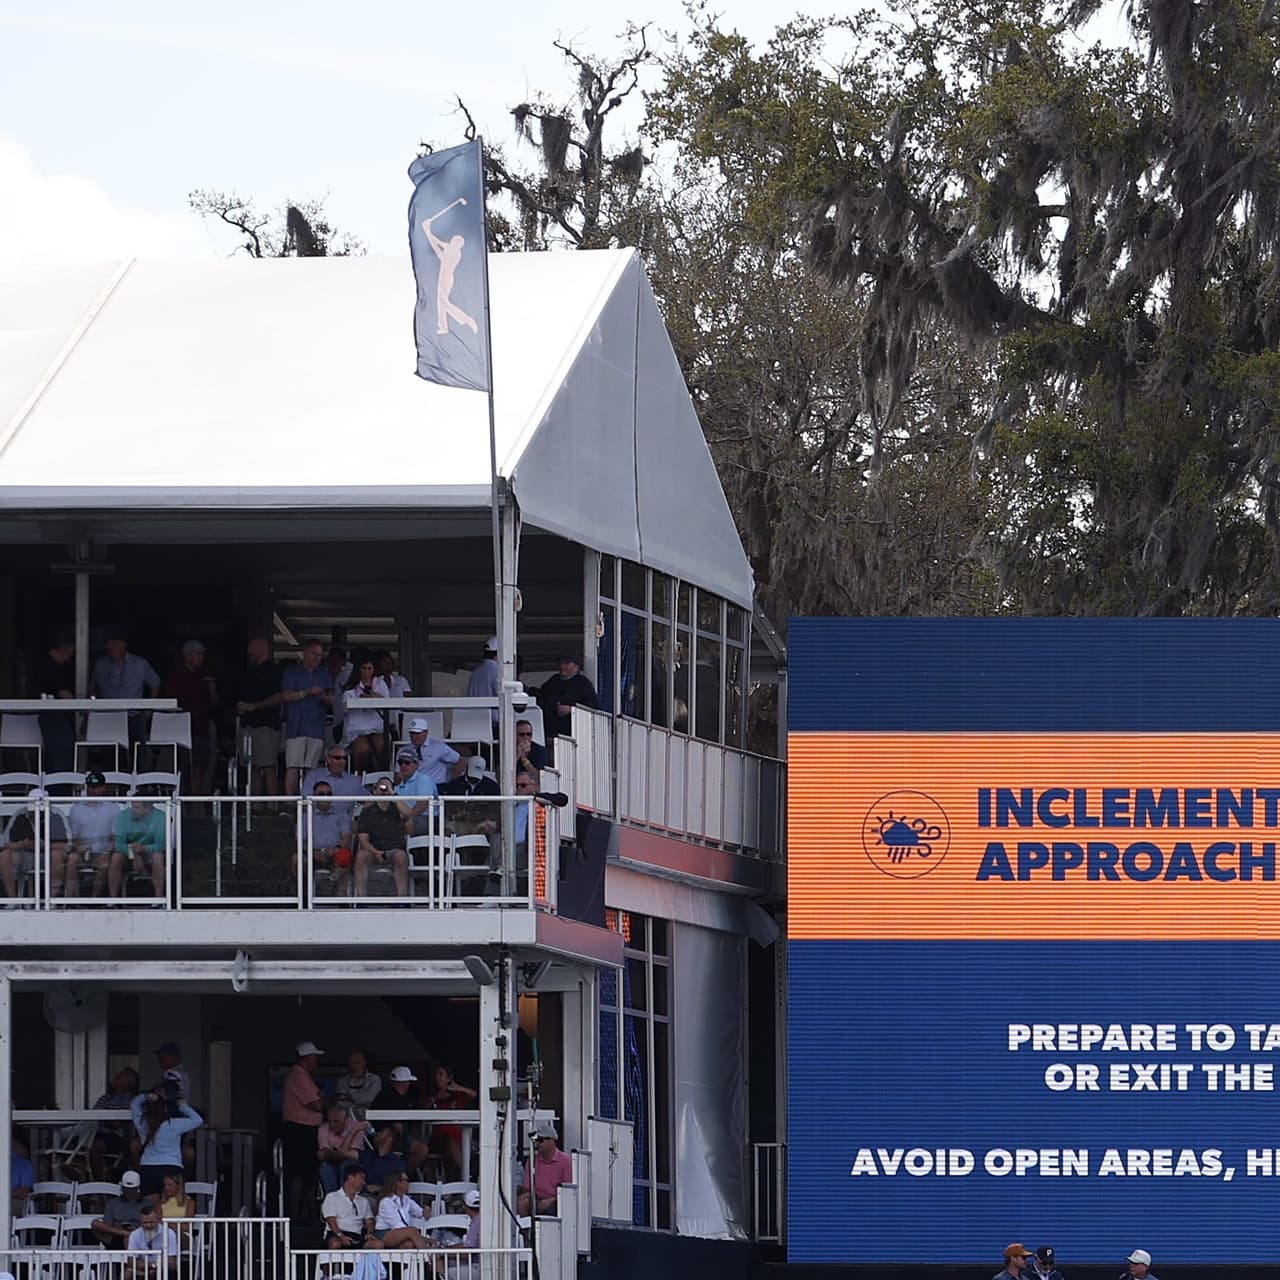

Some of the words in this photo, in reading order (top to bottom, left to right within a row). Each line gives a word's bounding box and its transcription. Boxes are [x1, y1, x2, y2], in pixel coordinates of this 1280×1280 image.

[1007, 1024, 1177, 1051] PREPARE
[1185, 1023, 1236, 1051] TO
[1044, 1063, 1101, 1091] OR
[1109, 1063, 1194, 1091] EXIT
[1201, 1063, 1274, 1091] THE
[851, 1148, 975, 1177] AVOID
[984, 1148, 1089, 1177] OPEN
[1098, 1148, 1236, 1182] AREAS,
